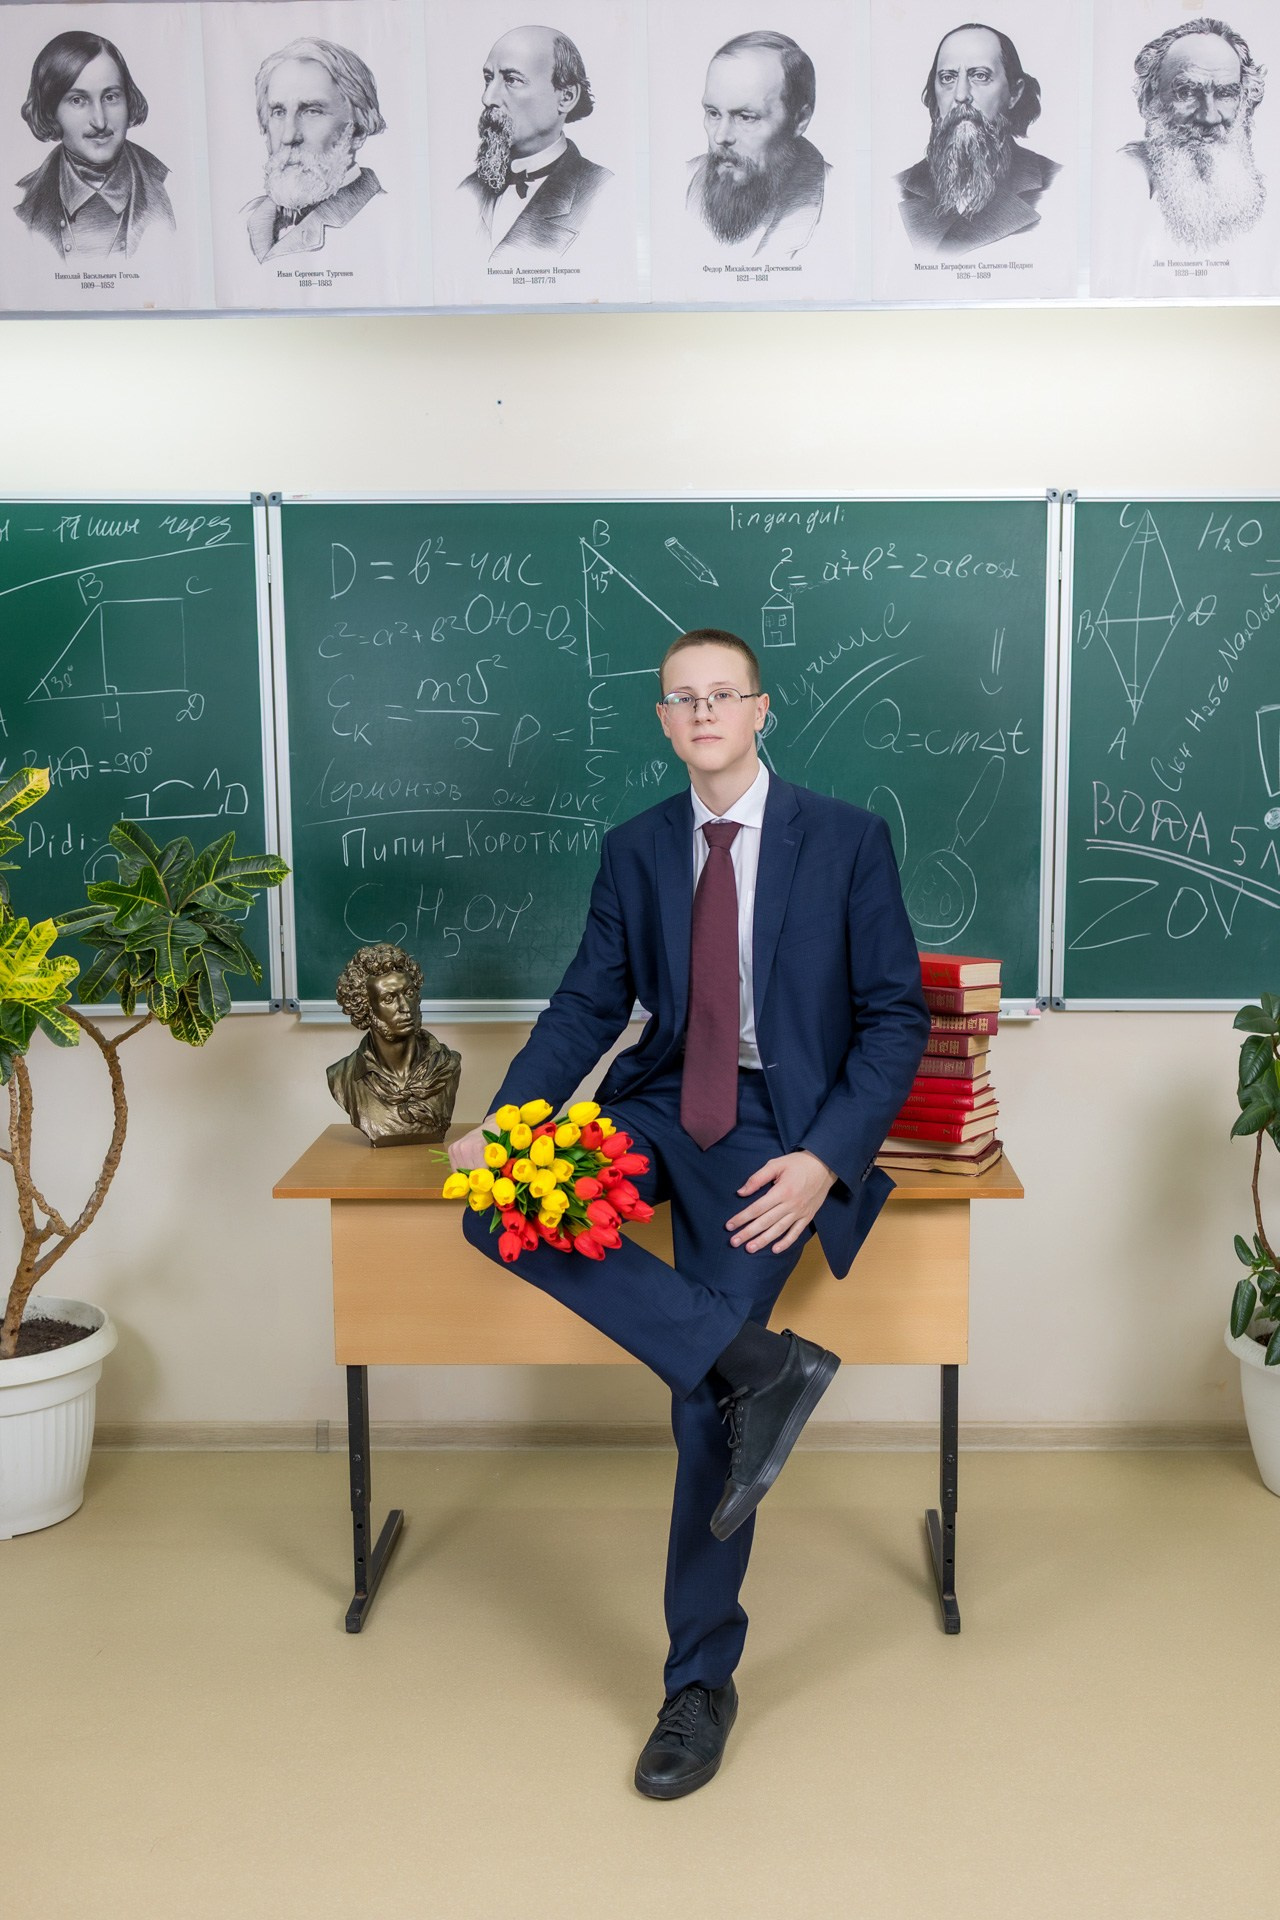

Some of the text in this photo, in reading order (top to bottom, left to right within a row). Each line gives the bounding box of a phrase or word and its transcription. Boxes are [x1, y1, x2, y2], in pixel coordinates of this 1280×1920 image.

[941, 263, 976, 271] Евграфович
[978, 262, 1033, 270] Салтыков-Щедрин
[1205, 259, 1230, 267] Толстой
[487, 267, 581, 275] Николай Алексеевич Некрасов
[764, 264, 803, 272] Достоевский
[55, 272, 80, 280] Николай
[119, 271, 140, 279] Гоголь
[277, 270, 354, 279] Иван Сергеевич Тургенев
[158, 515, 232, 546] через
